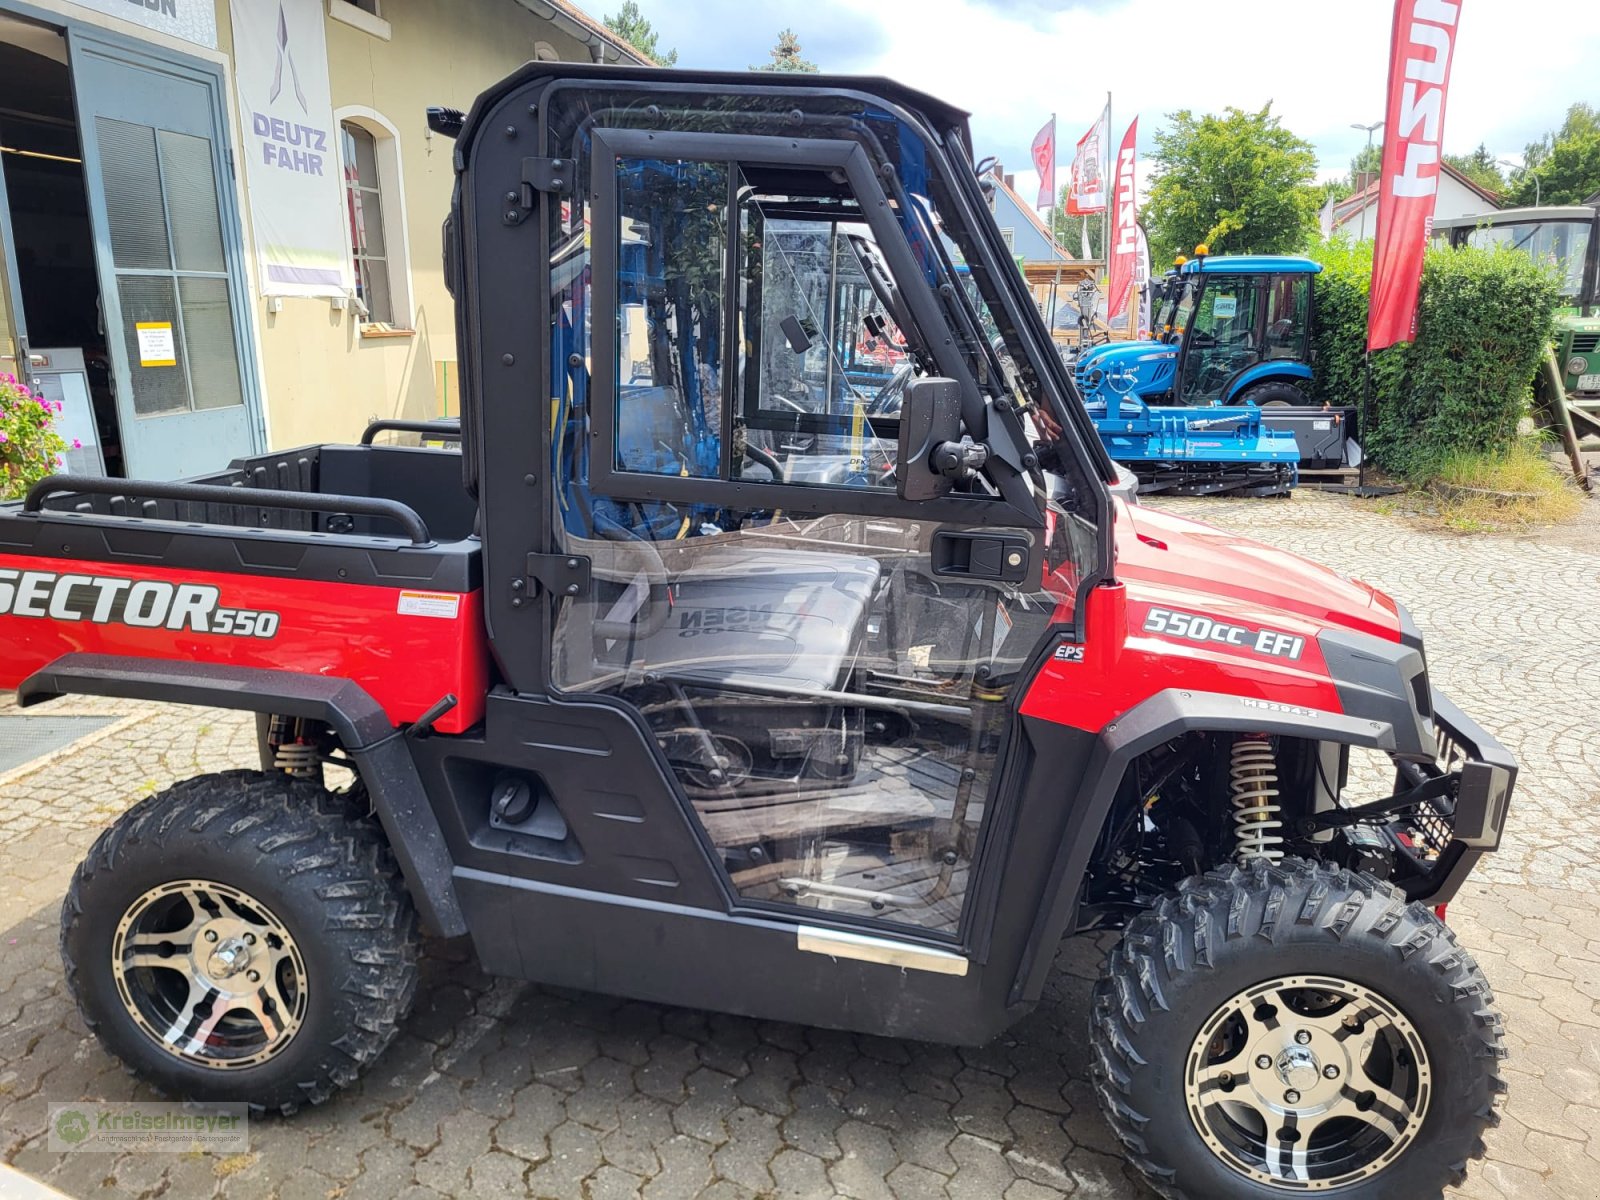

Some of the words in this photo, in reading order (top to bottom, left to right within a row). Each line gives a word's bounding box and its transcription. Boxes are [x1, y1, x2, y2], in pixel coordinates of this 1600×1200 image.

[253, 112, 327, 152] DEUTZ
[263, 142, 323, 176] FAHR
[212, 609, 279, 637] 550
[1055, 645, 1084, 659] EPS
[1254, 630, 1302, 659] EFI
